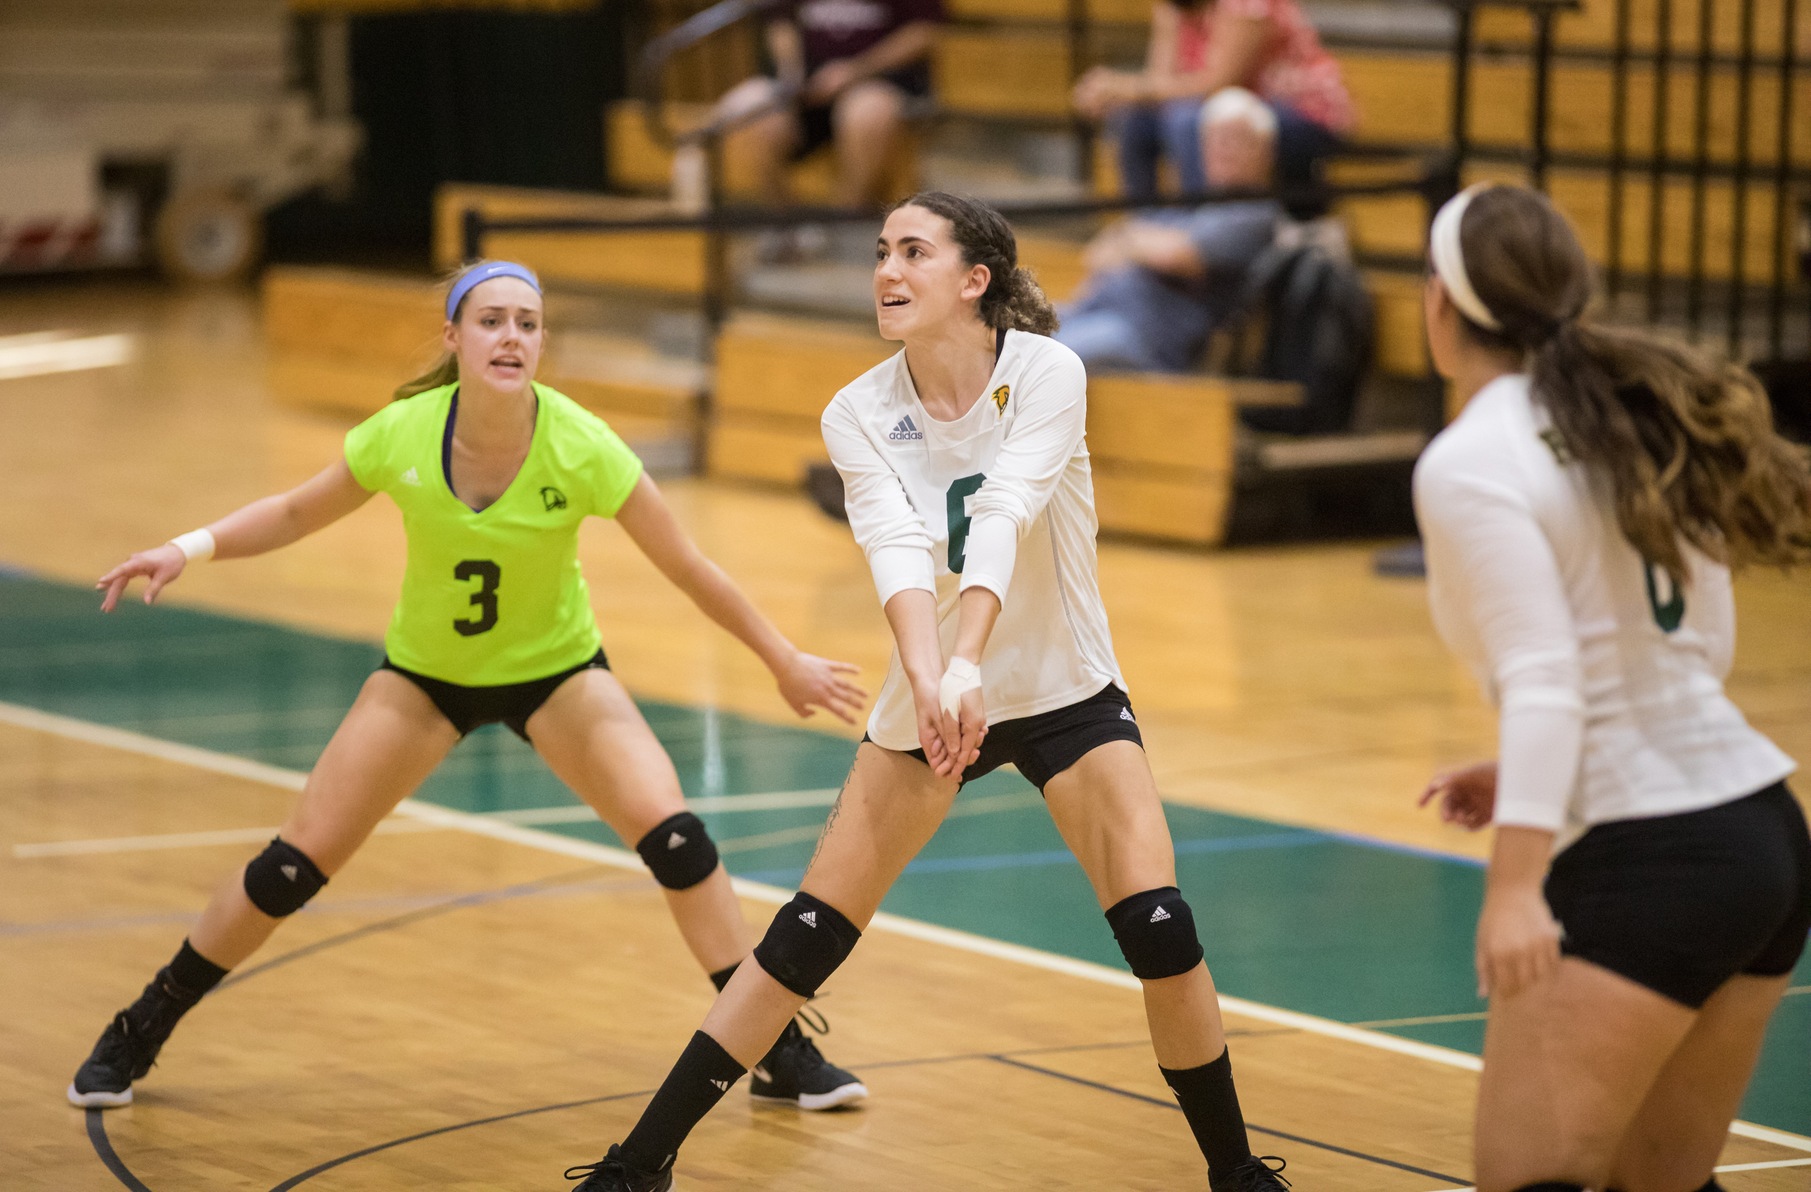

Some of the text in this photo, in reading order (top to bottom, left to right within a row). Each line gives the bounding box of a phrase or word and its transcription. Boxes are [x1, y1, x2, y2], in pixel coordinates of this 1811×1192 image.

[888, 430, 923, 440] adidas
[453, 559, 501, 637] 3
[1150, 912, 1171, 923] adidas
